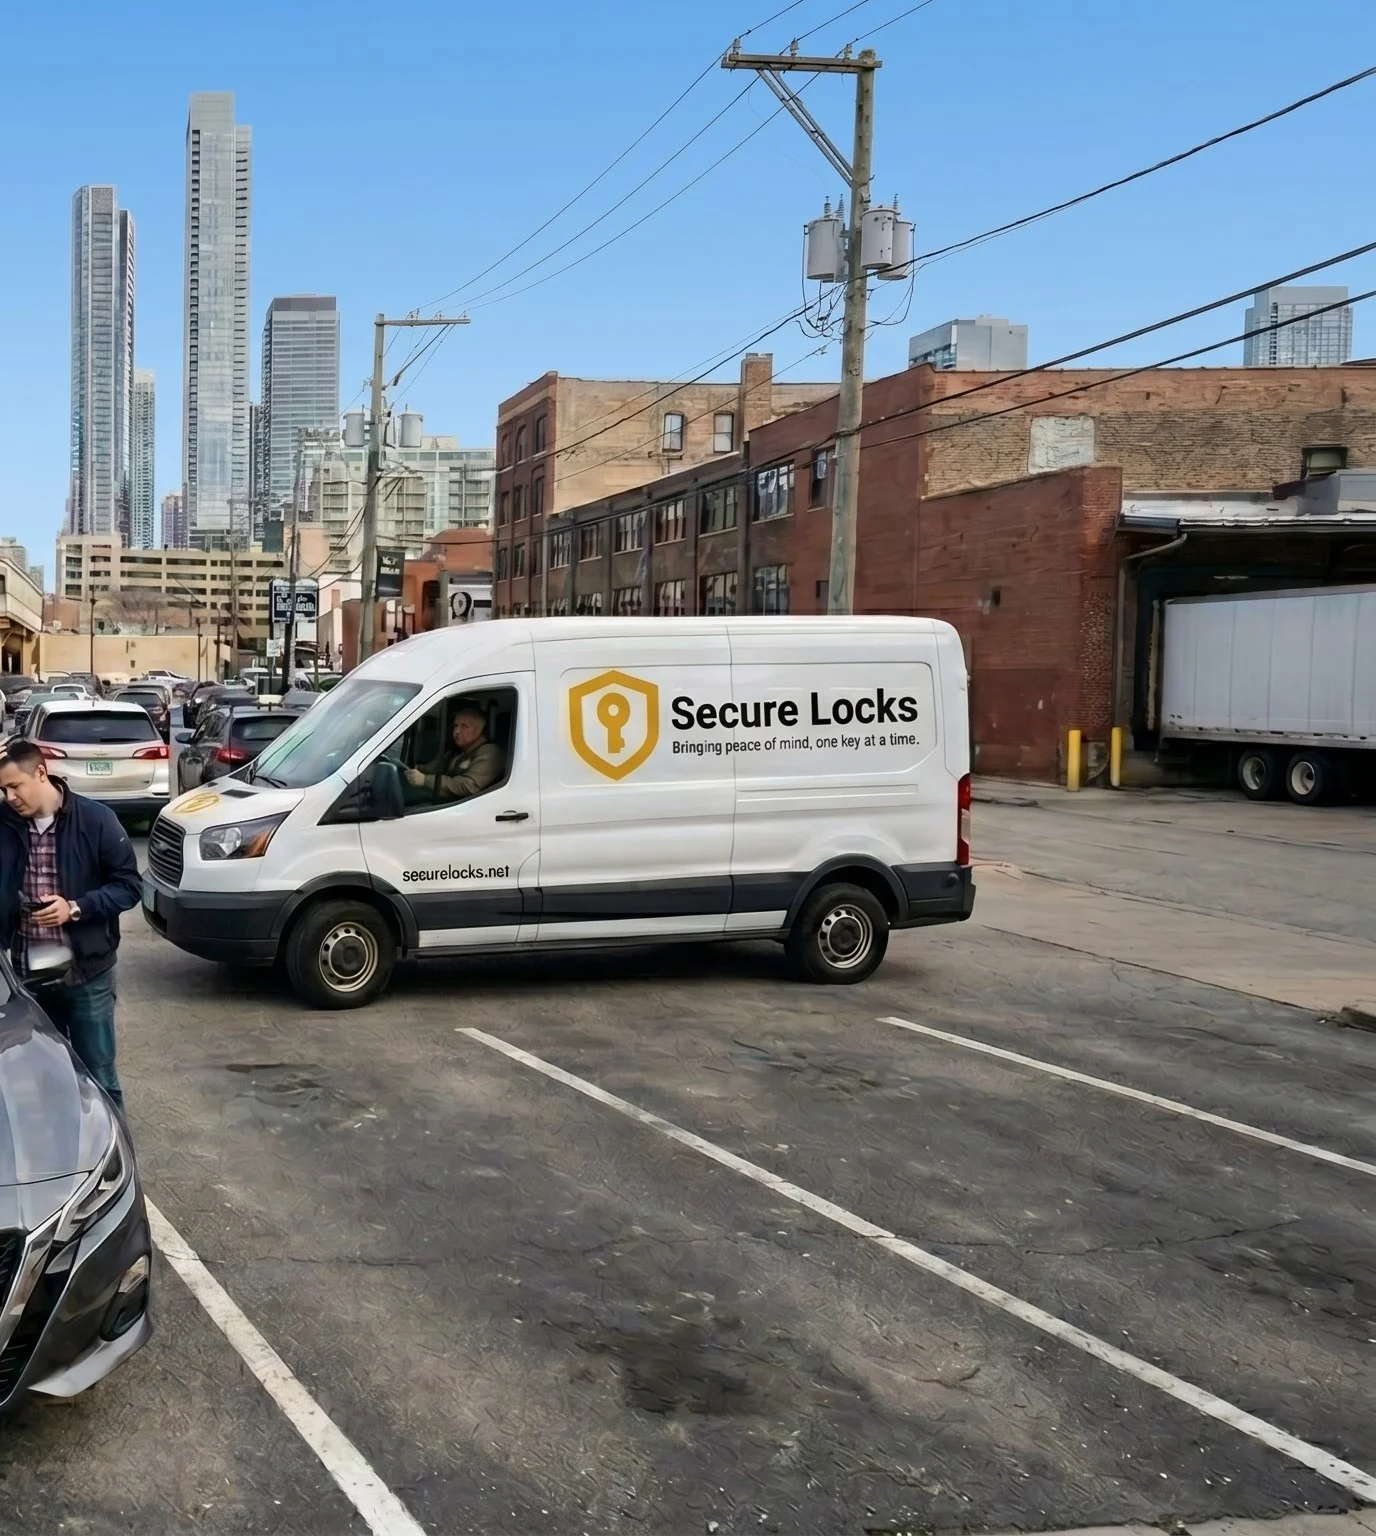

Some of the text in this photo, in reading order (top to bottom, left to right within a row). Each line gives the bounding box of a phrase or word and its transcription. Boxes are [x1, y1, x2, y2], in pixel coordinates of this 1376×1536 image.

[671, 688, 918, 731] Secure Locks
[672, 732, 920, 756] Bringing peace of mind, one key at a time.
[402, 864, 510, 882] securelocks.net
